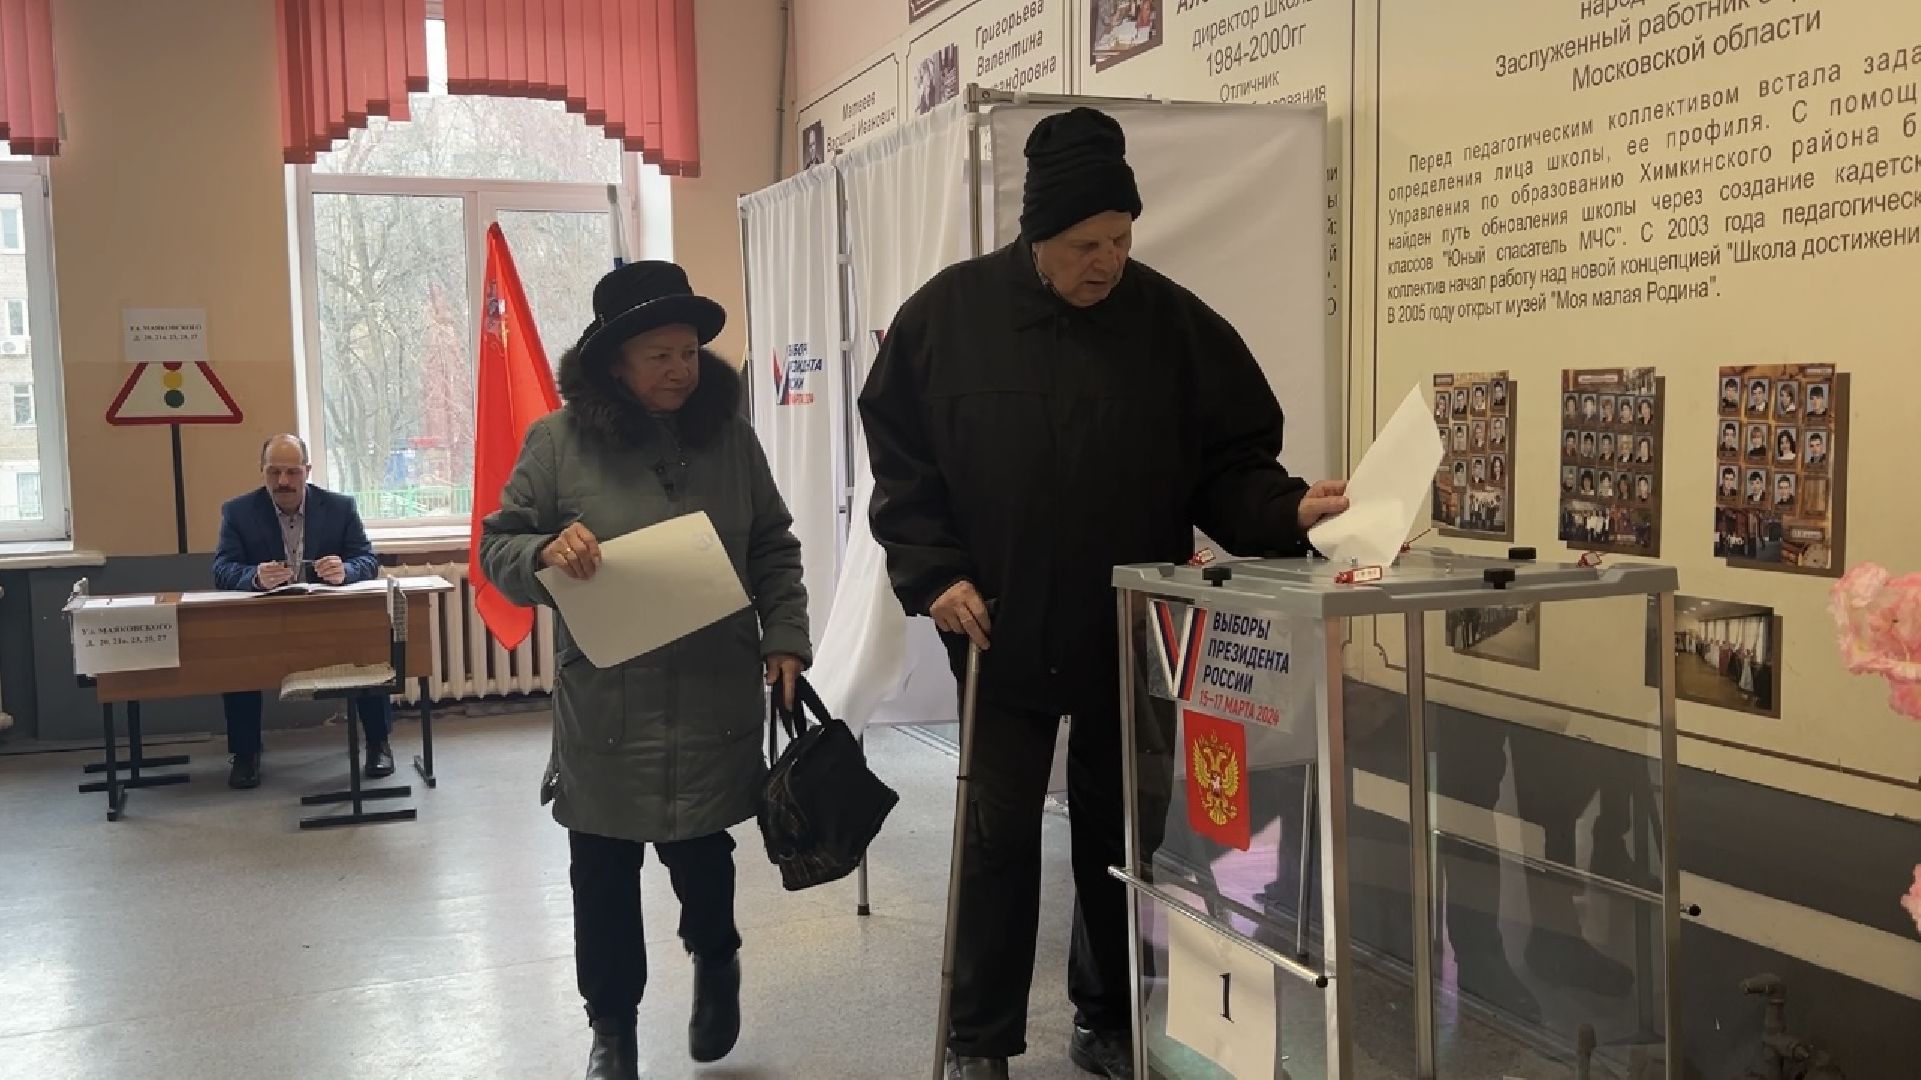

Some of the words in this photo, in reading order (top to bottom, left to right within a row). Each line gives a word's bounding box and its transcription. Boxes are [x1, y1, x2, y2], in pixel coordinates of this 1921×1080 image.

[976, 0, 1044, 50] Григорьева
[1192, 5, 1259, 51] директор
[1206, 24, 1306, 76] 1984-2000гг
[1495, 17, 1631, 77] Заслуженный
[1572, 35, 1705, 91] Московской
[1713, 9, 1821, 55] области
[977, 29, 1043, 77] Валентина
[1220, 70, 1280, 103] Отличник
[1409, 151, 1452, 173] Перед
[1464, 119, 1593, 161] педагогическим
[1609, 86, 1739, 130] коллективом
[1759, 63, 1841, 98] встала
[1389, 171, 1482, 201] определения
[1494, 160, 1533, 181] лица
[1547, 146, 1611, 171] школы,
[1627, 137, 1649, 156] ее
[1667, 114, 1770, 151] профиля.
[1792, 99, 1808, 123] С
[1389, 200, 1470, 226] Управления
[1482, 194, 1499, 211] по
[1511, 171, 1624, 206] образованию
[1641, 145, 1772, 183] Химкинского
[1792, 126, 1879, 163] района
[1389, 231, 1431, 251] найден
[1442, 225, 1471, 246] путь
[1482, 209, 1568, 237] обновления
[1581, 200, 1636, 222] школы
[1651, 188, 1703, 213] через
[1720, 171, 1815, 201] создание
[1388, 255, 1434, 276] классов
[1442, 245, 1485, 267] "Юный
[1496, 238, 1567, 261] спасатель
[1579, 225, 1627, 251] МЧС".
[1640, 221, 1653, 243] С
[1667, 214, 1709, 240] 2003
[1726, 211, 1765, 233] года
[1388, 279, 1446, 300] коллектив
[1448, 274, 1485, 293] начал
[1490, 268, 1536, 293] работу
[1540, 266, 1567, 285] над
[1571, 257, 1616, 280] новой
[1620, 245, 1720, 275] концепцией
[1727, 239, 1796, 264] "Школа
[1387, 305, 1395, 324] В
[1398, 304, 1426, 323] 2005
[1429, 304, 1454, 324] году
[1457, 300, 1502, 320] открыт
[1505, 293, 1546, 318] музей
[1551, 290, 1588, 309] "Моя
[1592, 287, 1642, 307] малая
[1647, 275, 1720, 303] Родина".
[1213, 611, 1271, 641] ВЫБОРЫ
[1202, 665, 1253, 694] РОССИИ
[1208, 638, 1289, 674] ПРЕЗИДЕНТА
[1224, 696, 1254, 720] МАРТА
[1256, 706, 1280, 726] 2024
[1219, 972, 1235, 1024] 1
